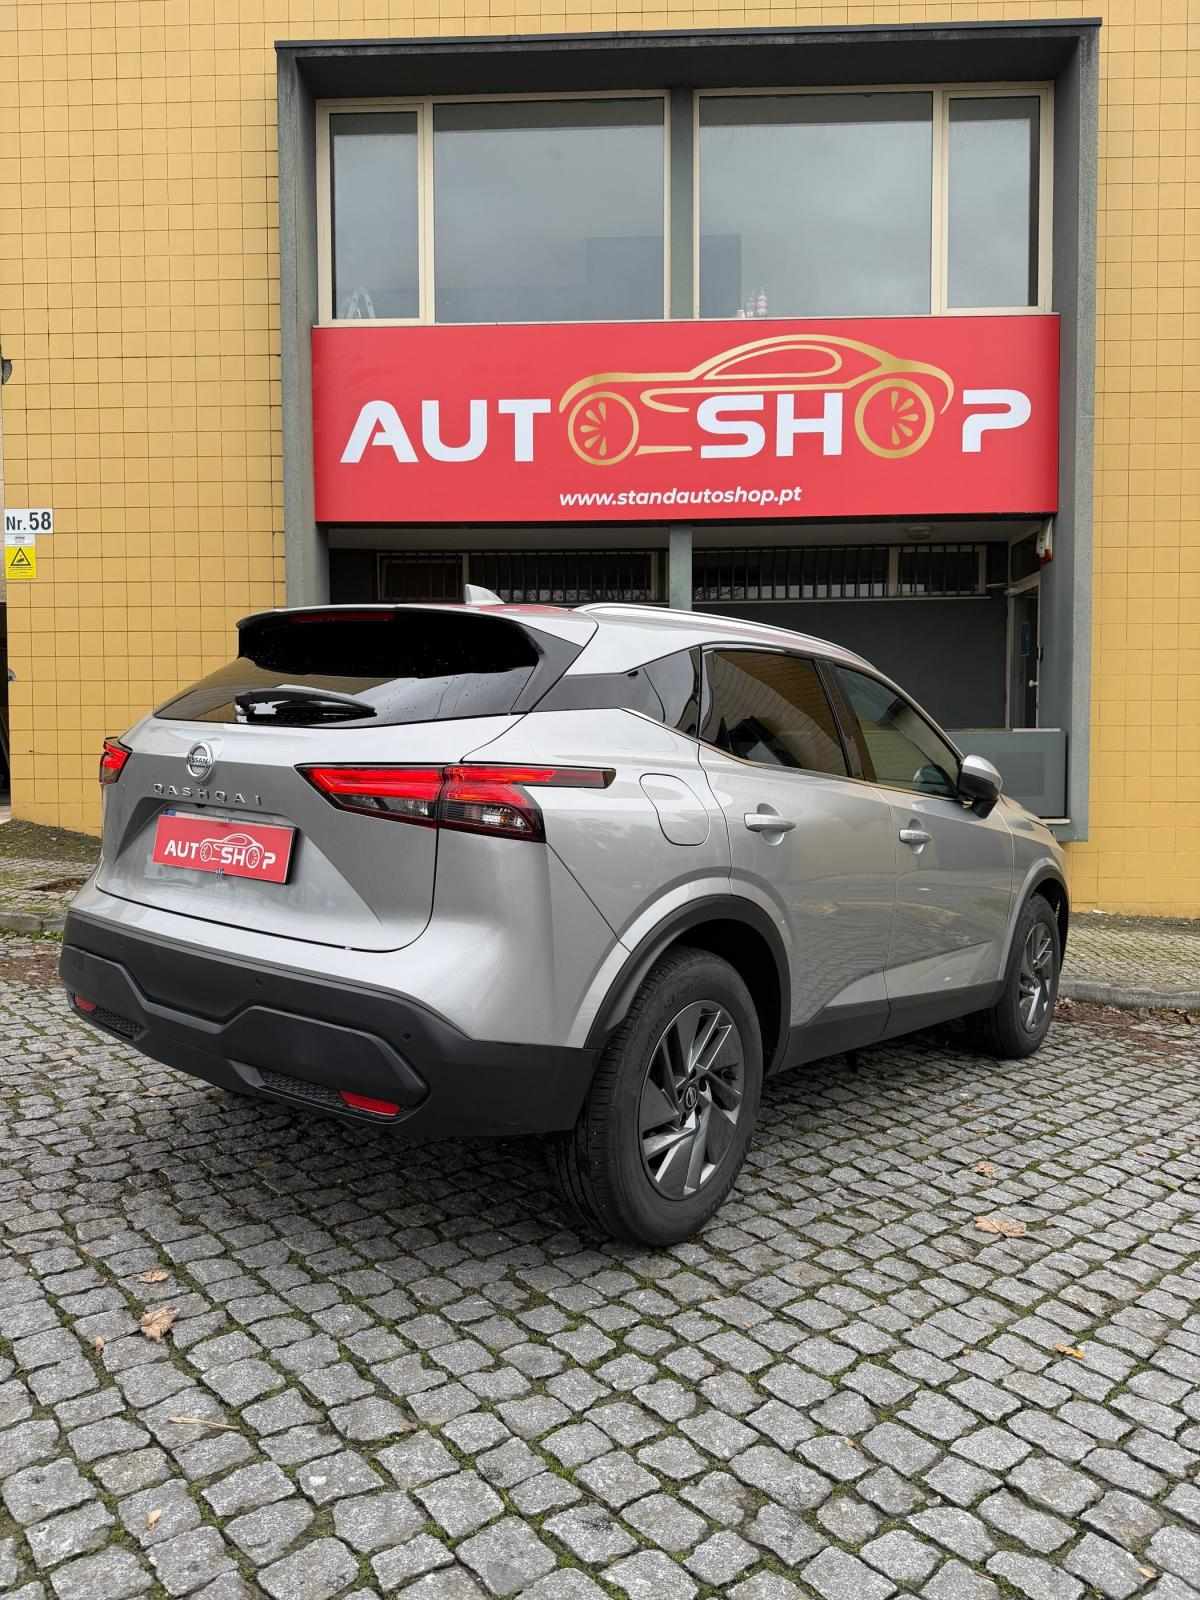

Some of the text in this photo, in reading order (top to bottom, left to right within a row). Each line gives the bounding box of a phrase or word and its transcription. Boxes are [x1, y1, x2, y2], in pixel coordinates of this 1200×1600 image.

[560, 486, 802, 507] www.standautoshop.pt
[6, 511, 51, 531] Nr. 58
[153, 783, 262, 805] QASHQAI
